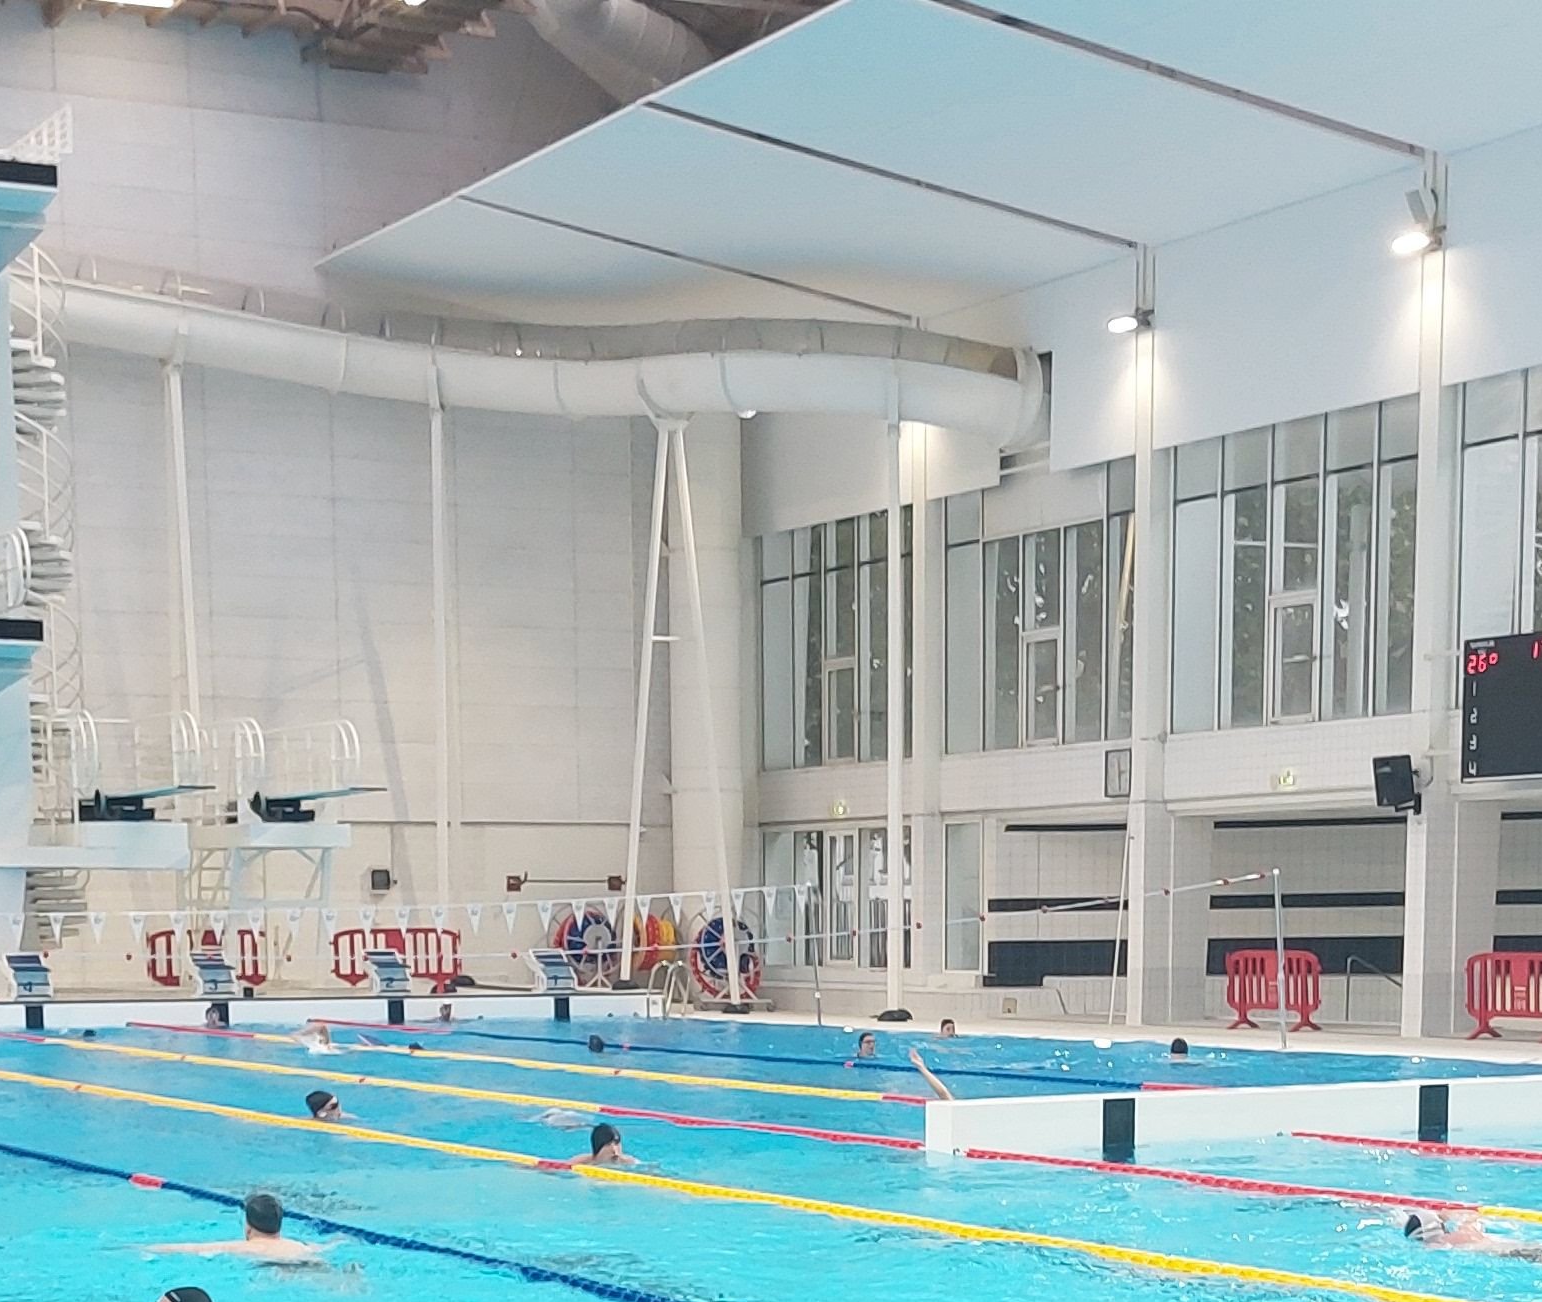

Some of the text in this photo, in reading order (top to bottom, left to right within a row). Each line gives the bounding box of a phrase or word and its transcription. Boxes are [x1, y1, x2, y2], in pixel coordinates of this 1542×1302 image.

[1470, 707, 1477, 723] 2
[1470, 734, 1477, 750] 3
[1468, 760, 1477, 776] 4
